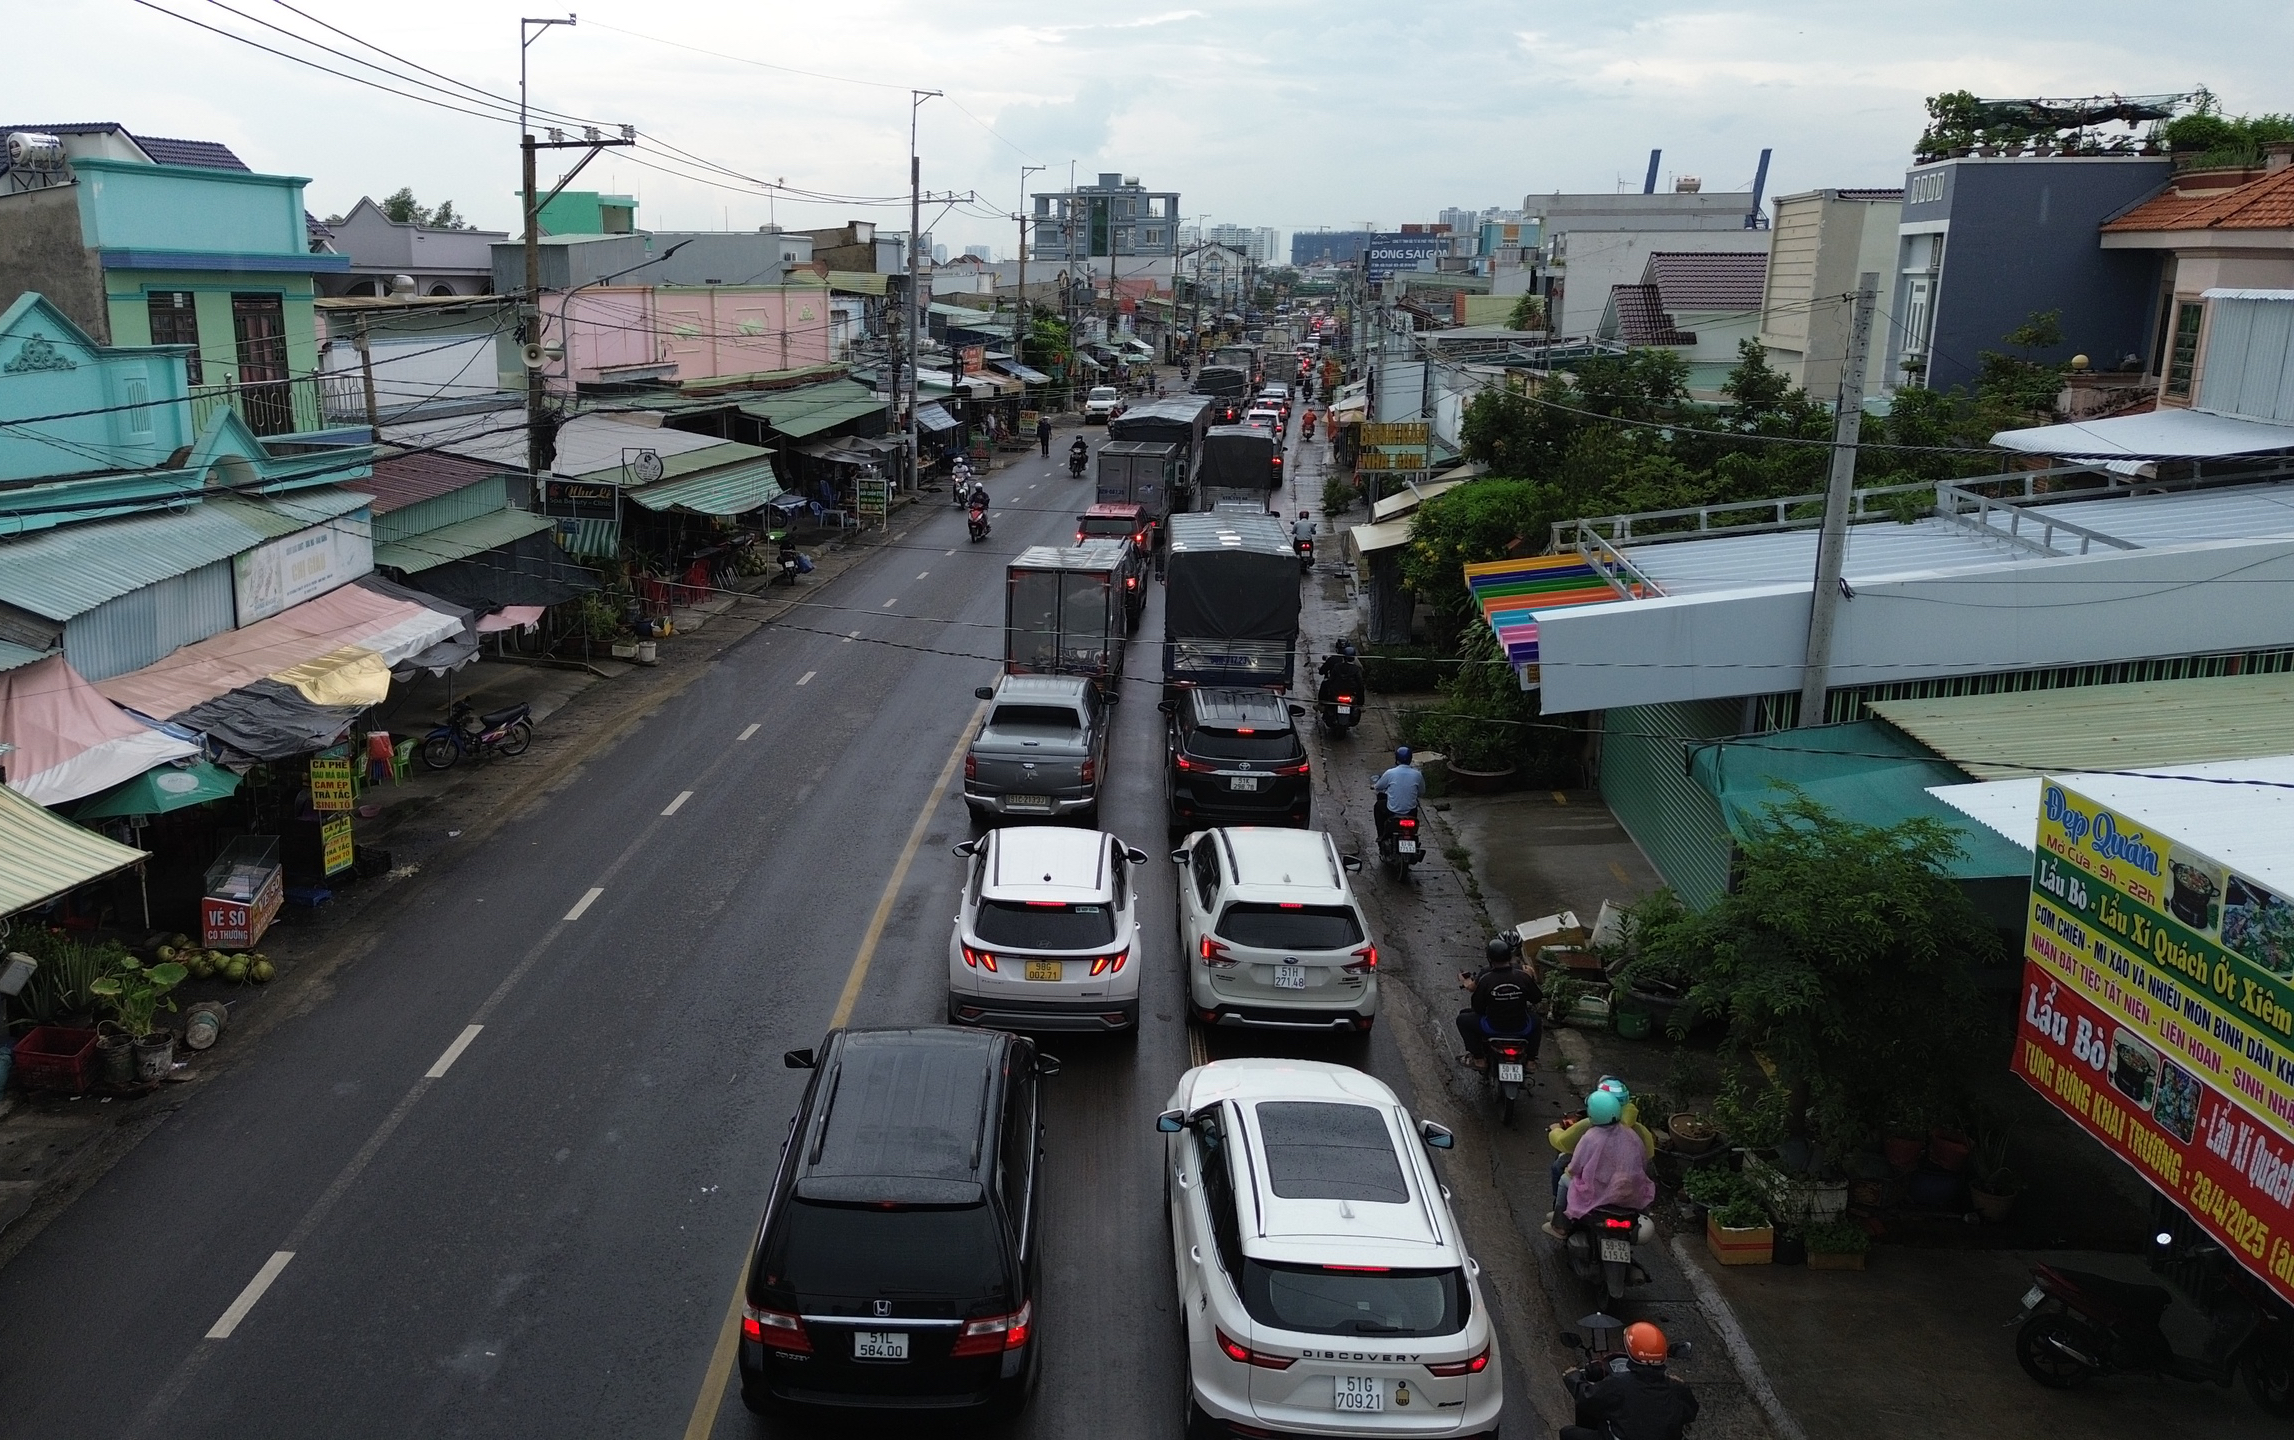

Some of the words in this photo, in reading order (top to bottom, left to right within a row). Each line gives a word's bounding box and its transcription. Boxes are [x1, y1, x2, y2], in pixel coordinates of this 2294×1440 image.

[1371, 247, 1404, 259] ĐÔNG
[1405, 247, 1425, 259] SÀI
[315, 781, 334, 789] CAM
[337, 779, 348, 789] ÉP
[314, 790, 331, 799] TRÀ
[333, 788, 350, 799] TẮC
[316, 801, 336, 809] SINH
[2044, 785, 2089, 845] Đẹp
[2092, 812, 2161, 877] Quán
[2046, 833, 2065, 854] Mở
[2067, 846, 2091, 870] Cửa
[2100, 862, 2117, 884] 9h
[2128, 879, 2156, 907] 22h
[209, 906, 225, 927] VÉ
[2038, 856, 2065, 900] Lẩu
[2067, 869, 2089, 911] Bò
[2098, 892, 2128, 936] Lẩu
[2154, 928, 2208, 988] Quách
[2212, 957, 2237, 1001] Ớt
[2240, 978, 2293, 1036] Xiêm
[1029, 971, 1057, 979] 002.71
[1281, 967, 1298, 977] 51H
[1275, 977, 1304, 988] 271.48
[2034, 902, 2056, 932] CƠM
[2057, 912, 2086, 951] CHIÊN
[2093, 938, 2107, 965] MÌ
[2109, 947, 2129, 979] XÀO
[2132, 959, 2146, 990] VÀ
[2183, 999, 2211, 1032] MÓN
[2213, 1011, 2244, 1054] BÌNH
[2246, 1038, 2275, 1073] DÂN
[2031, 931, 2057, 964] NHẬN
[2059, 947, 2079, 978] ĐẶT
[2079, 961, 2101, 993] TIỆC
[2104, 973, 2123, 1006] TẤT
[2124, 992, 2150, 1027] NIÊN
[2159, 1014, 2186, 1051] LIÊN
[2187, 1036, 2222, 1075] HOAN
[2232, 1066, 2265, 1104] SINH
[2025, 980, 2069, 1047] Lẩu
[2072, 1014, 2107, 1072] Bò
[2206, 1100, 2235, 1161] Lẩu
[2091, 1090, 2127, 1142] KHAI
[2127, 1115, 2183, 1189] TRƯƠNG
[2190, 1170, 2270, 1259] 28/4/2025
[870, 1332, 893, 1343] 51L
[860, 1345, 903, 1357] 584.00
[1303, 1350, 1421, 1362] DISCOVERY
[1347, 1376, 1373, 1392] 51G
[1337, 1392, 1381, 1409] 709.21
